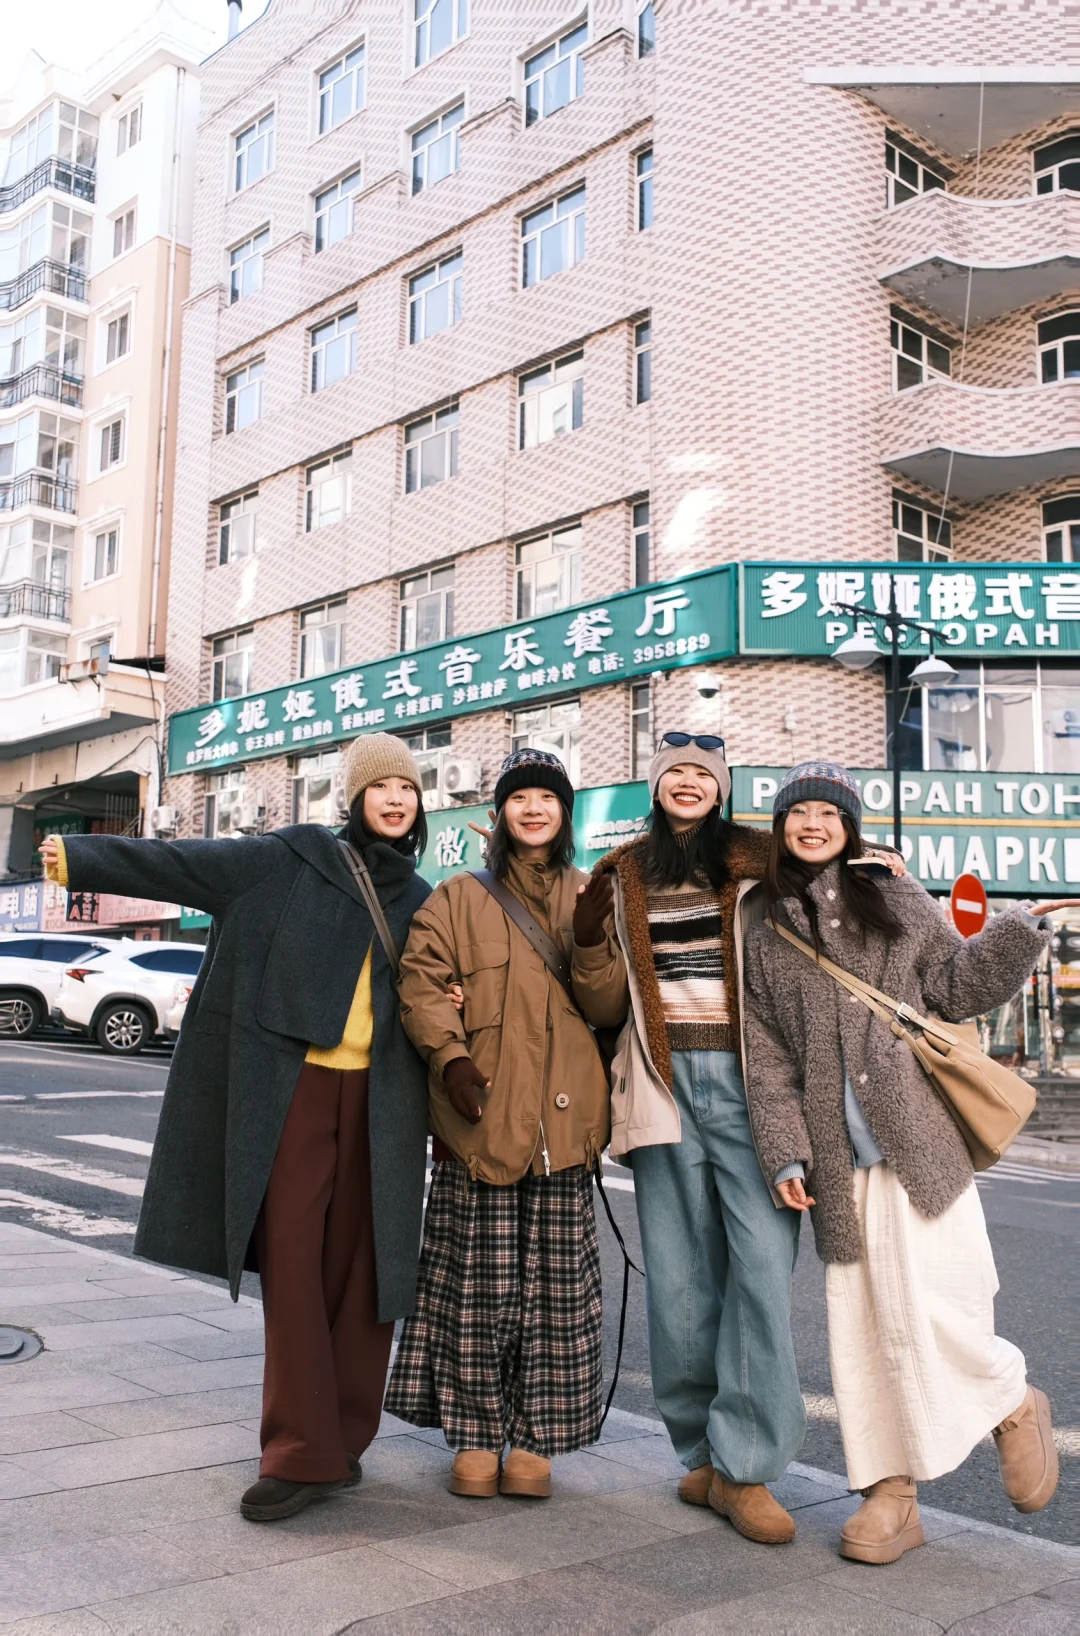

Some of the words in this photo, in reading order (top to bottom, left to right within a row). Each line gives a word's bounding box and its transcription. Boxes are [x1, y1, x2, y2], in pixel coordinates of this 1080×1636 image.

[195, 588, 691, 749] 多妮娅俄式音乐餐厅
[517, 661, 577, 691] 咖啡冷饮
[633, 633, 711, 664] 3958889
